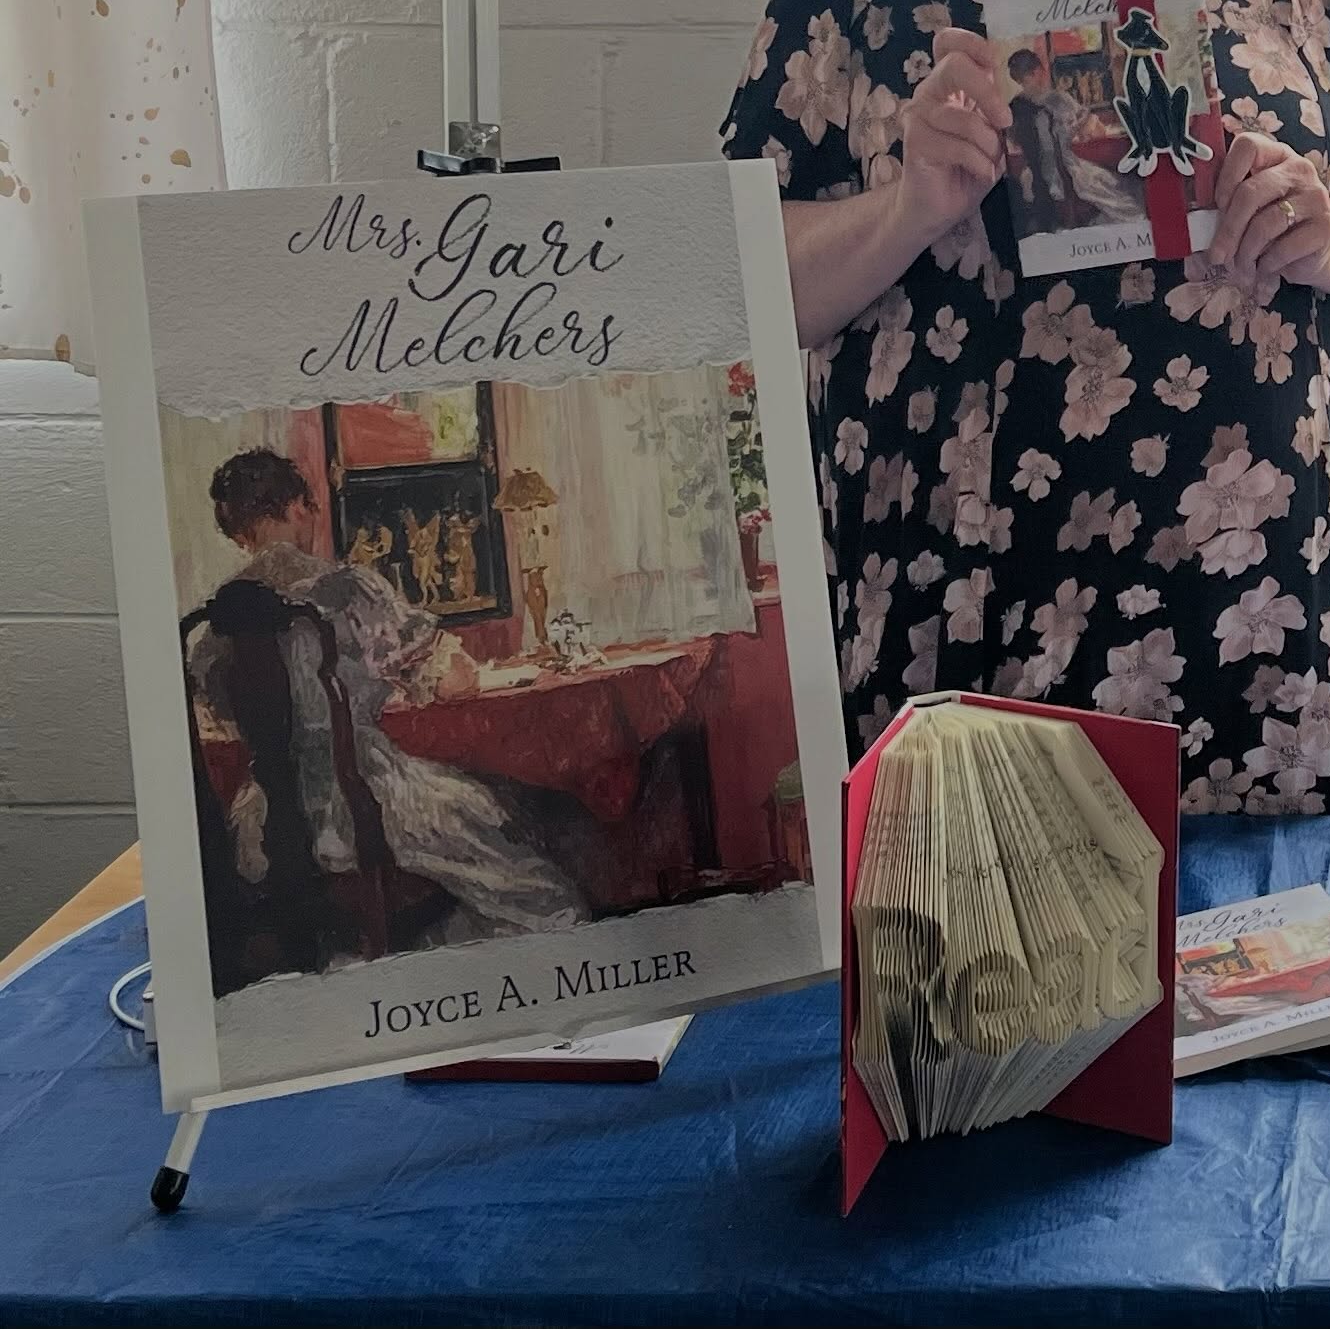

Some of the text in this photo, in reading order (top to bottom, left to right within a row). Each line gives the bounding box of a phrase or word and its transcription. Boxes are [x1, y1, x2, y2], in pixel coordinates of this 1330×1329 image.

[288, 193, 624, 301] Mrs. Gari
[300, 282, 624, 376] Melchers
[364, 950, 696, 1038] JOYCE A. MILLER
